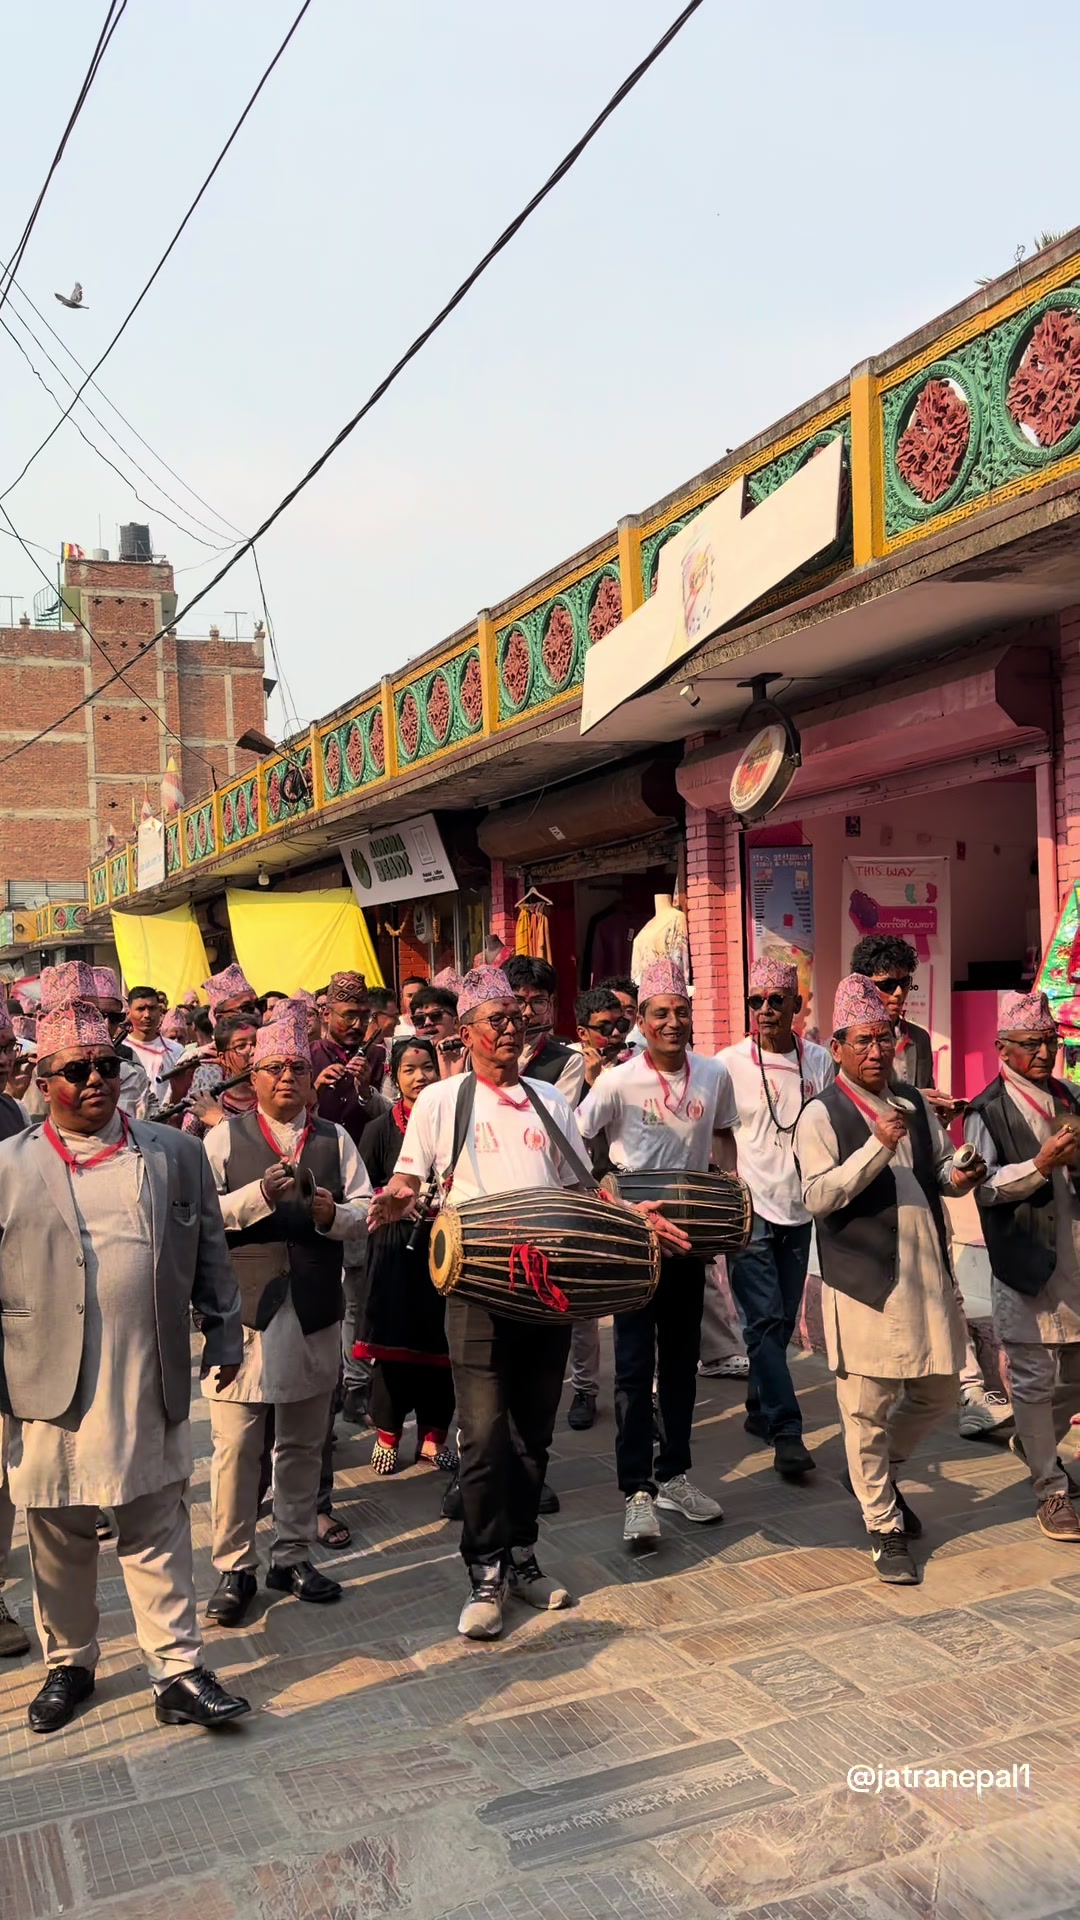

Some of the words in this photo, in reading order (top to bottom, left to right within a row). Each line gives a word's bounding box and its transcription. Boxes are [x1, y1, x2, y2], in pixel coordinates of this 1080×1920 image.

[369, 833, 406, 858] AURORA
[373, 851, 413, 882] BEADS
[855, 866, 882, 877] THIS
[886, 866, 916, 877] WAY
